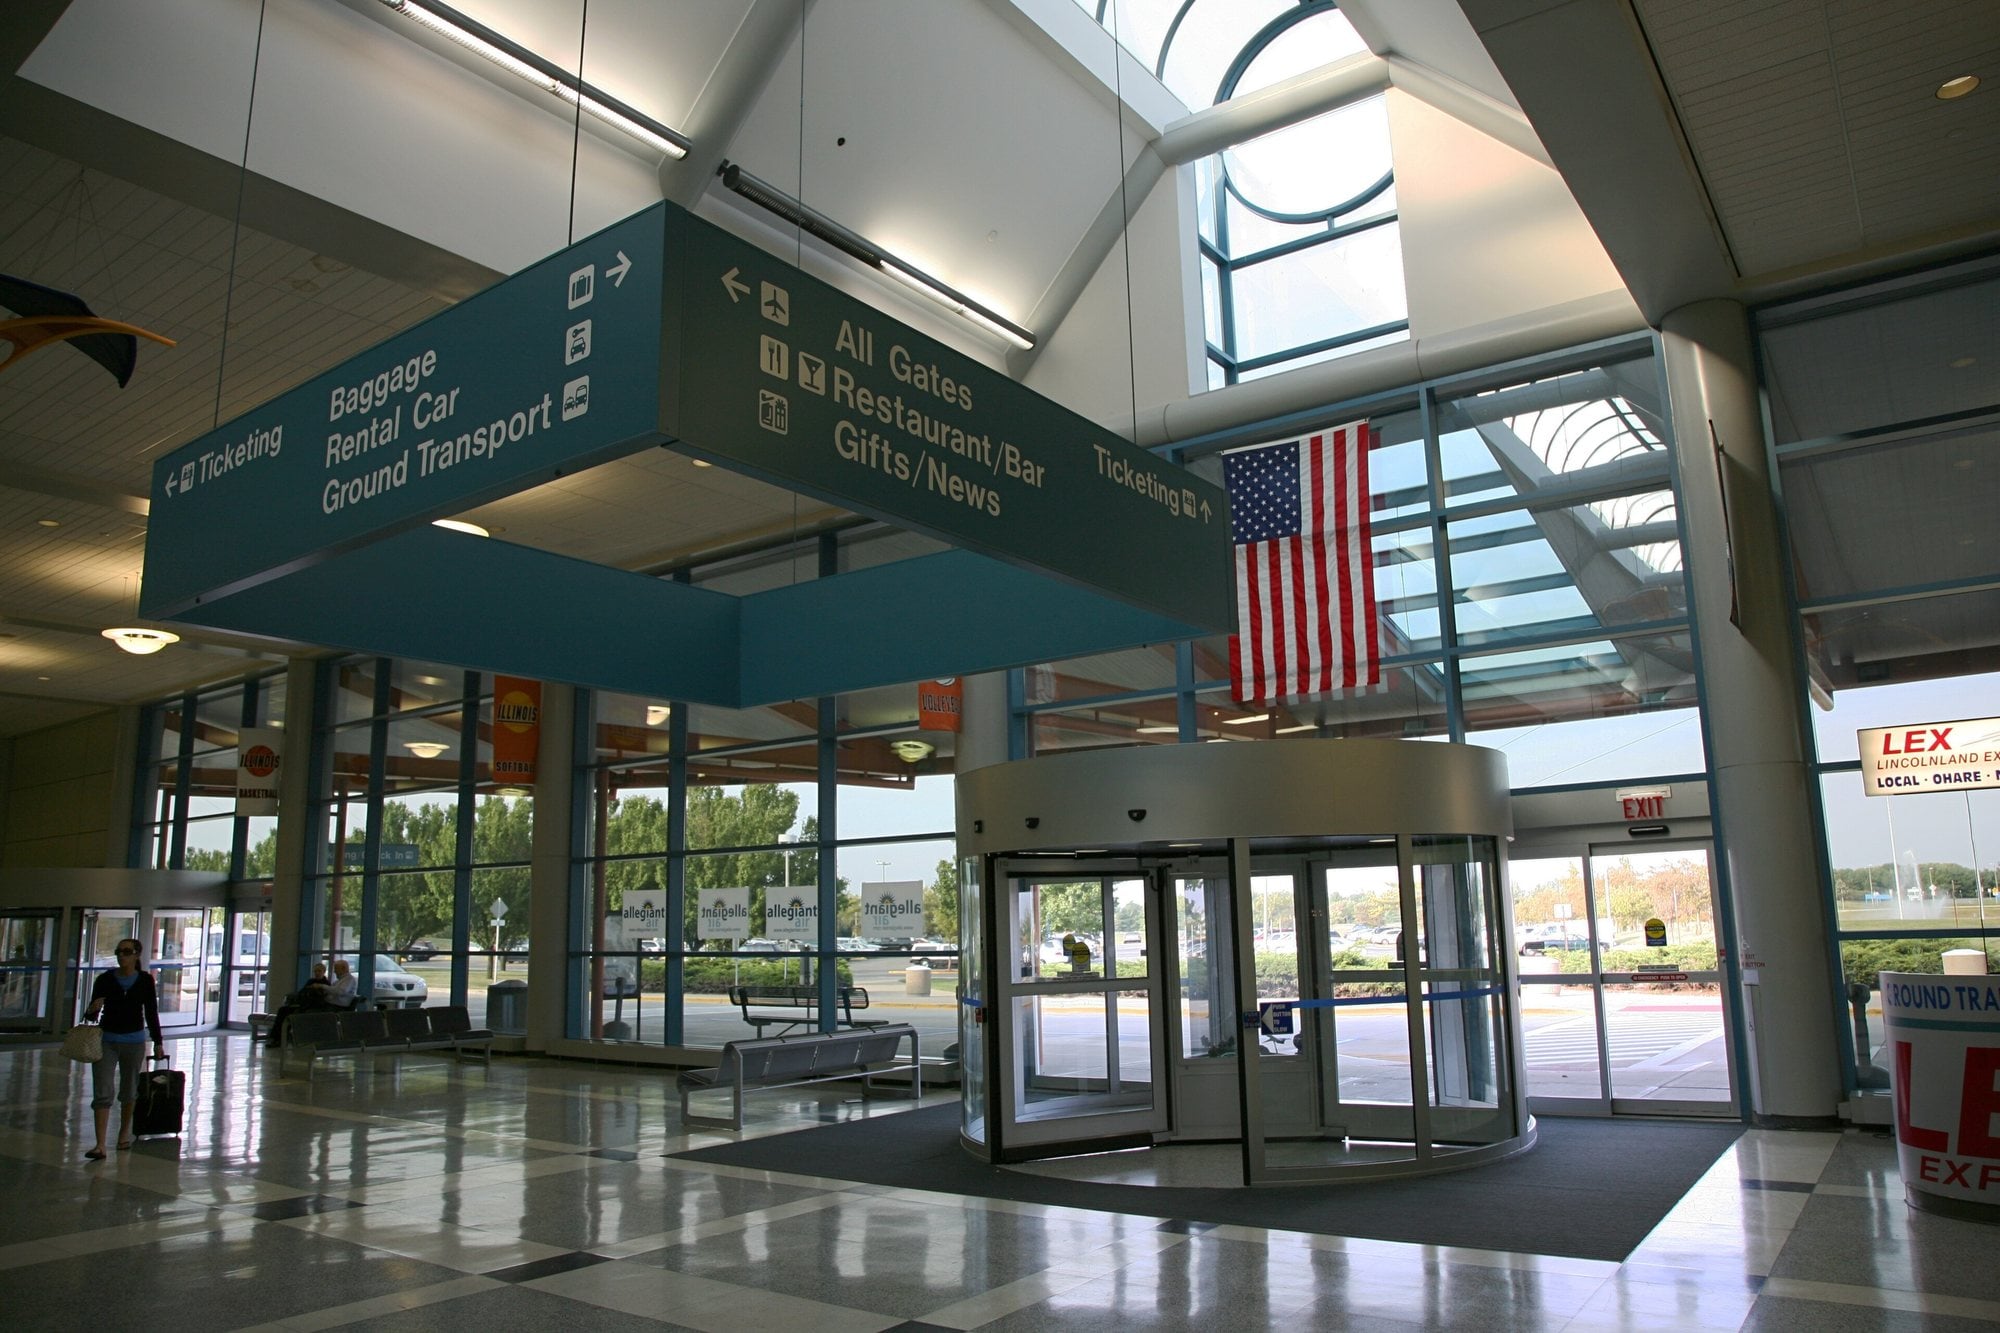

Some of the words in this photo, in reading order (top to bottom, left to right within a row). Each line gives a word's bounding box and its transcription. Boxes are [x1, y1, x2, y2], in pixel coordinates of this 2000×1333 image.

[834, 319, 873, 366] All
[889, 345, 973, 411] Gates
[329, 350, 437, 422] Baggage
[325, 405, 401, 469] Rental
[413, 387, 460, 430] Car
[199, 424, 283, 484] Ticketing
[322, 449, 409, 514] Ground
[417, 393, 553, 477] Transport
[834, 420, 1001, 516] Gifts/News
[1093, 443, 1180, 517] Ticketing
[497, 703, 538, 721] ILLINOIS
[1883, 727, 1953, 755] LEX
[240, 754, 280, 768] ILLINOIS
[1877, 752, 1979, 770] LINCOLNLAND
[1877, 775, 1920, 788] LOCAL
[1932, 771, 1982, 785] OHARE
[1623, 795, 1663, 819] EXIT
[623, 905, 665, 921] allegiant
[767, 903, 818, 921] allegiant
[794, 917, 810, 928] air
[1955, 986, 2000, 1011] TRA
